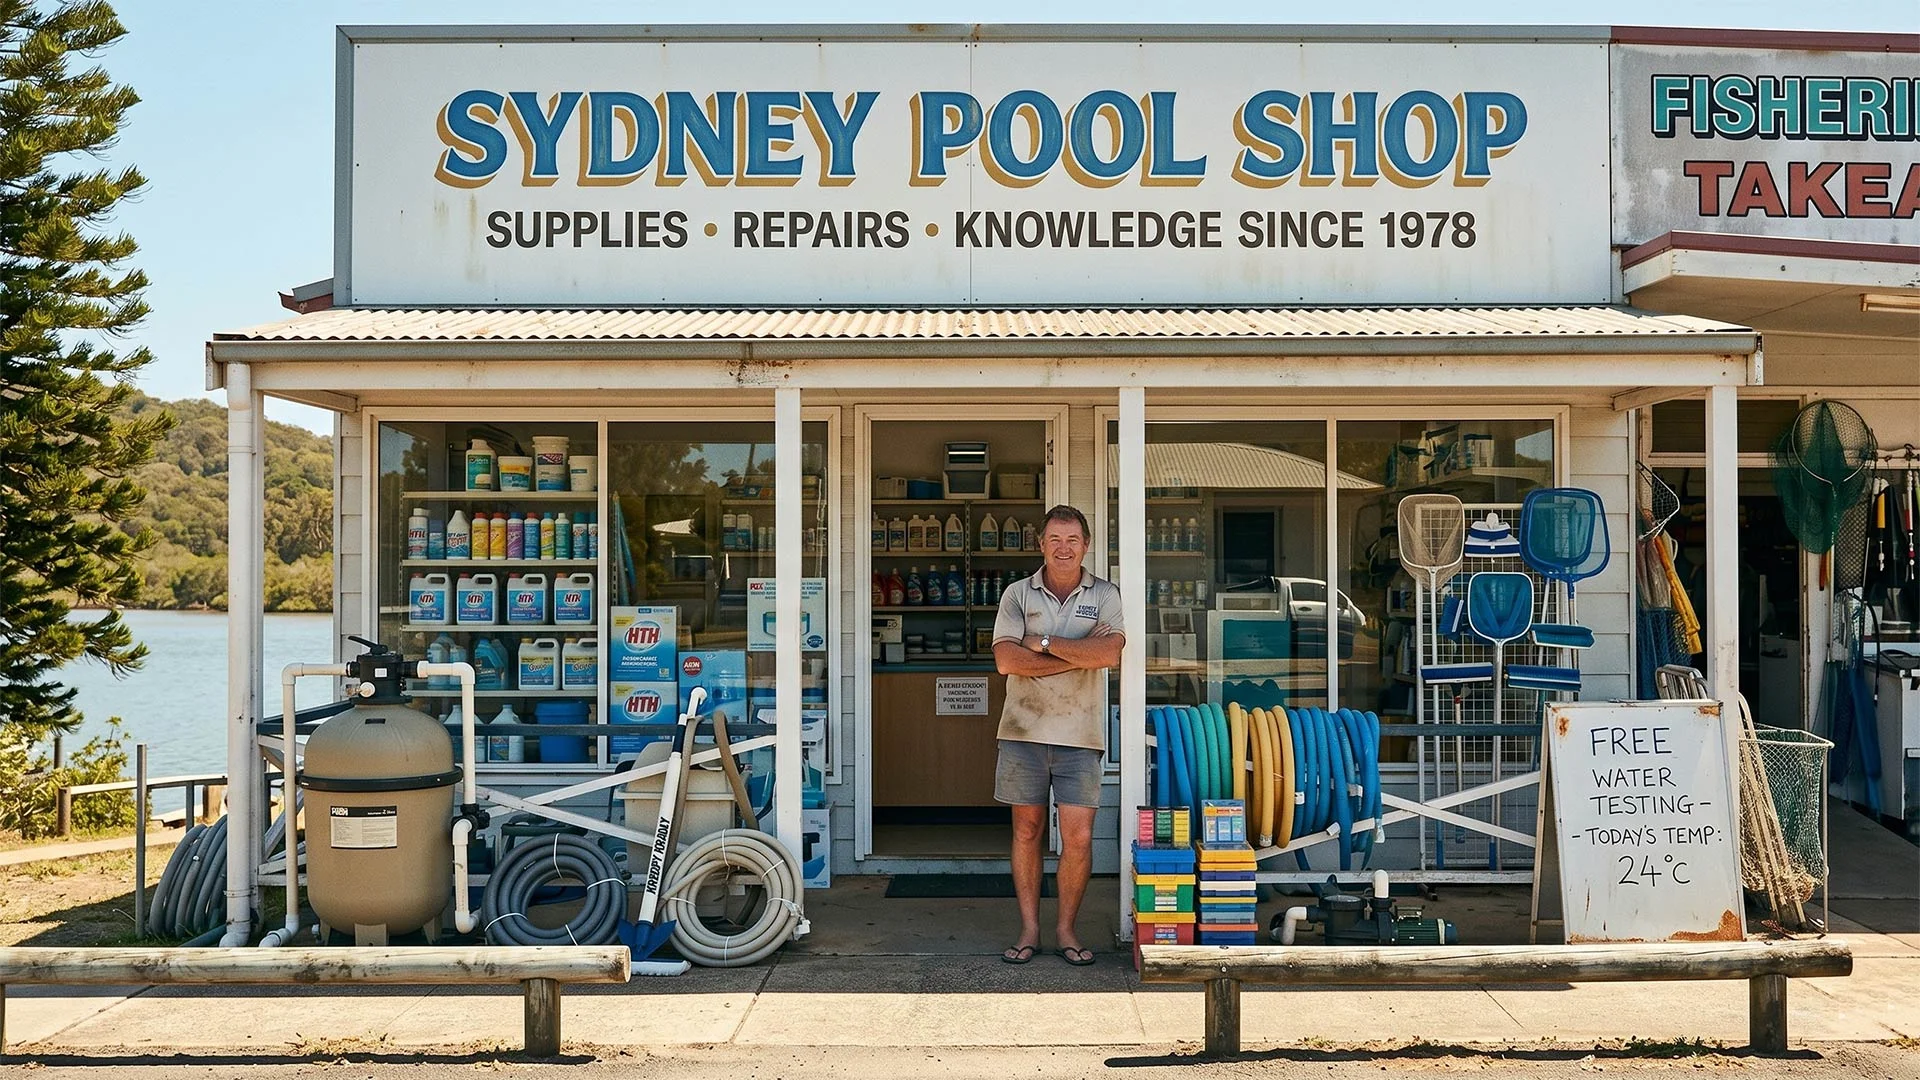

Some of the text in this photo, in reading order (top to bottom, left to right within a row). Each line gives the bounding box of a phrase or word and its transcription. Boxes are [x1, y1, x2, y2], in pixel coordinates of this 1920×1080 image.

[1651, 74, 1920, 141] FISHERI
[435, 89, 1528, 188] SYDNEY POOL SHOP
[486, 210, 1477, 249] SUPPLIES REPAIRS KNOWLEDGE SINCE 1978
[627, 627, 661, 644] HTH
[627, 696, 660, 712] HTH
[1590, 726, 1673, 757] FREE
[1592, 766, 1677, 788] WATER
[1589, 794, 1695, 816] TESTING
[1584, 824, 1657, 847] TODAY'S
[1662, 825, 1723, 846] TEMP:
[1618, 854, 1691, 887] 24°C
